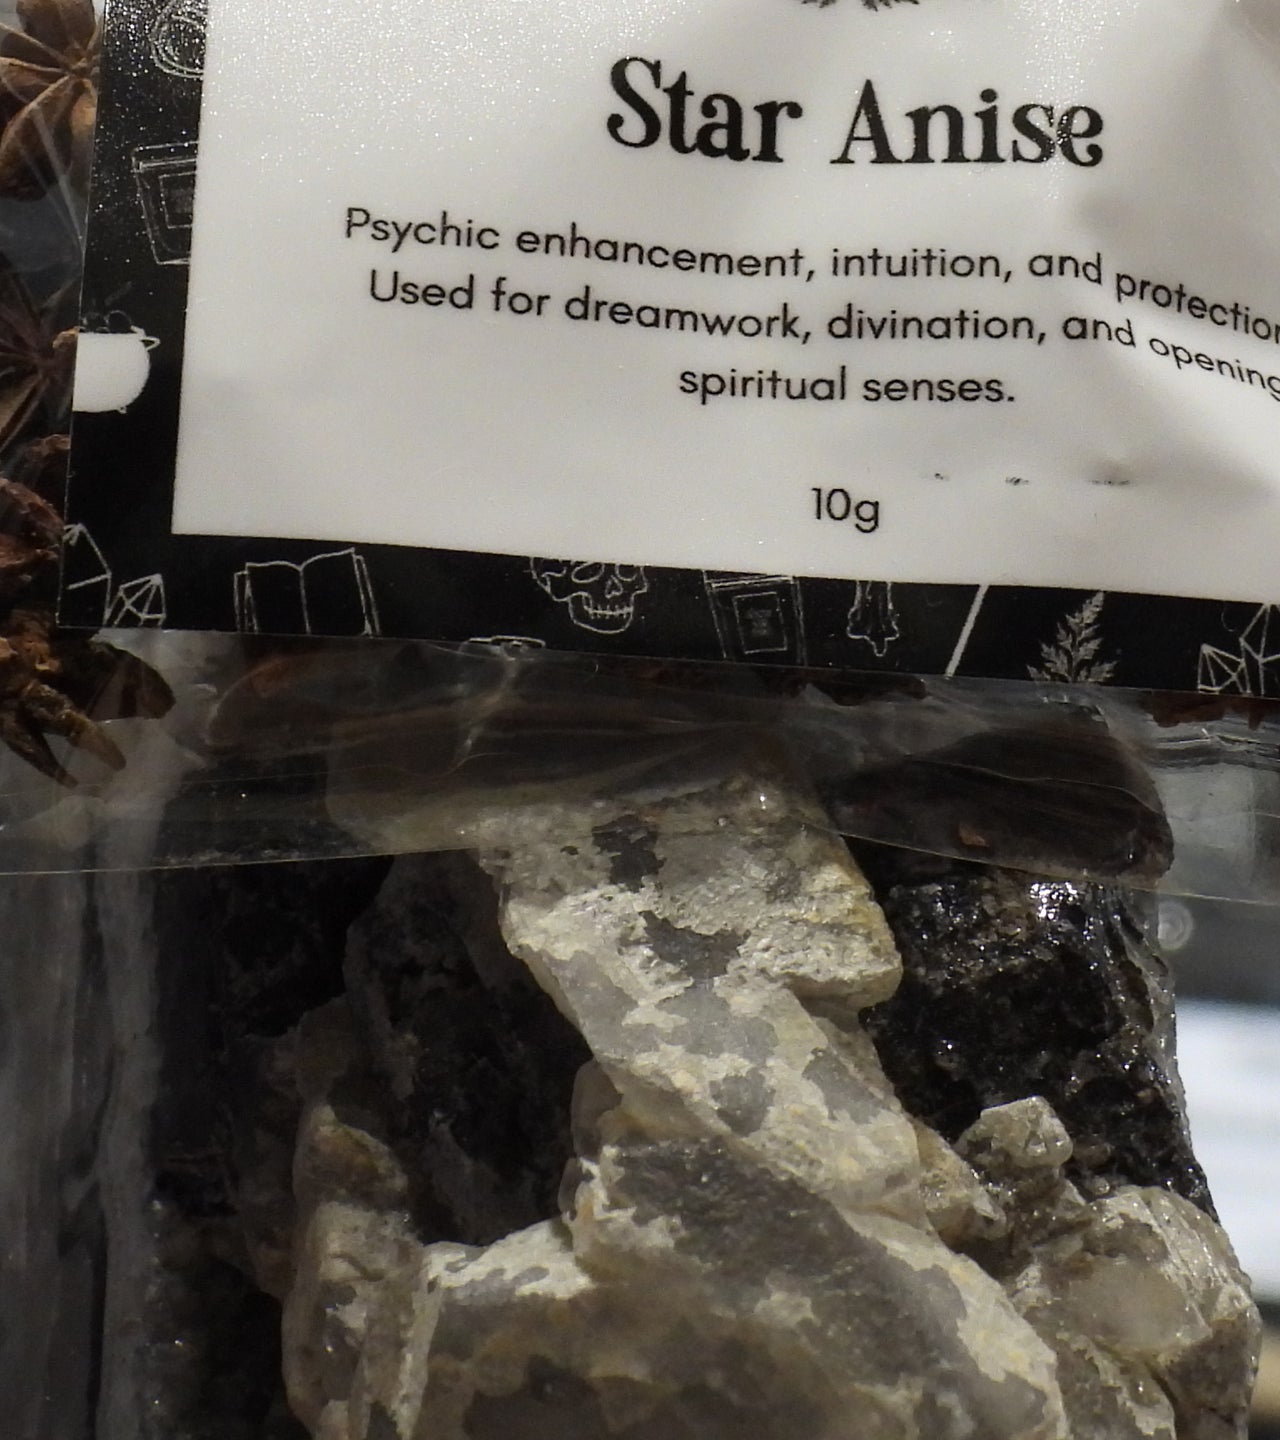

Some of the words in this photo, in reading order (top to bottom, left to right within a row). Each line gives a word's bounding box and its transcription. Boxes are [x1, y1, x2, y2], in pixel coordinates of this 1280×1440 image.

[606, 56, 804, 163] Star
[829, 78, 1104, 167] Anise
[344, 206, 501, 254] Psychic
[514, 220, 816, 283] enhancement,
[831, 247, 1013, 284] intuition,
[1027, 251, 1103, 286] and
[369, 268, 476, 311] Used
[489, 275, 552, 317] for
[563, 284, 812, 346] dreamwork,
[826, 301, 1047, 347] divination,
[1060, 317, 1137, 349] and
[678, 364, 847, 406] spiritual
[861, 376, 1016, 404] senses.
[810, 486, 881, 535] 10g
